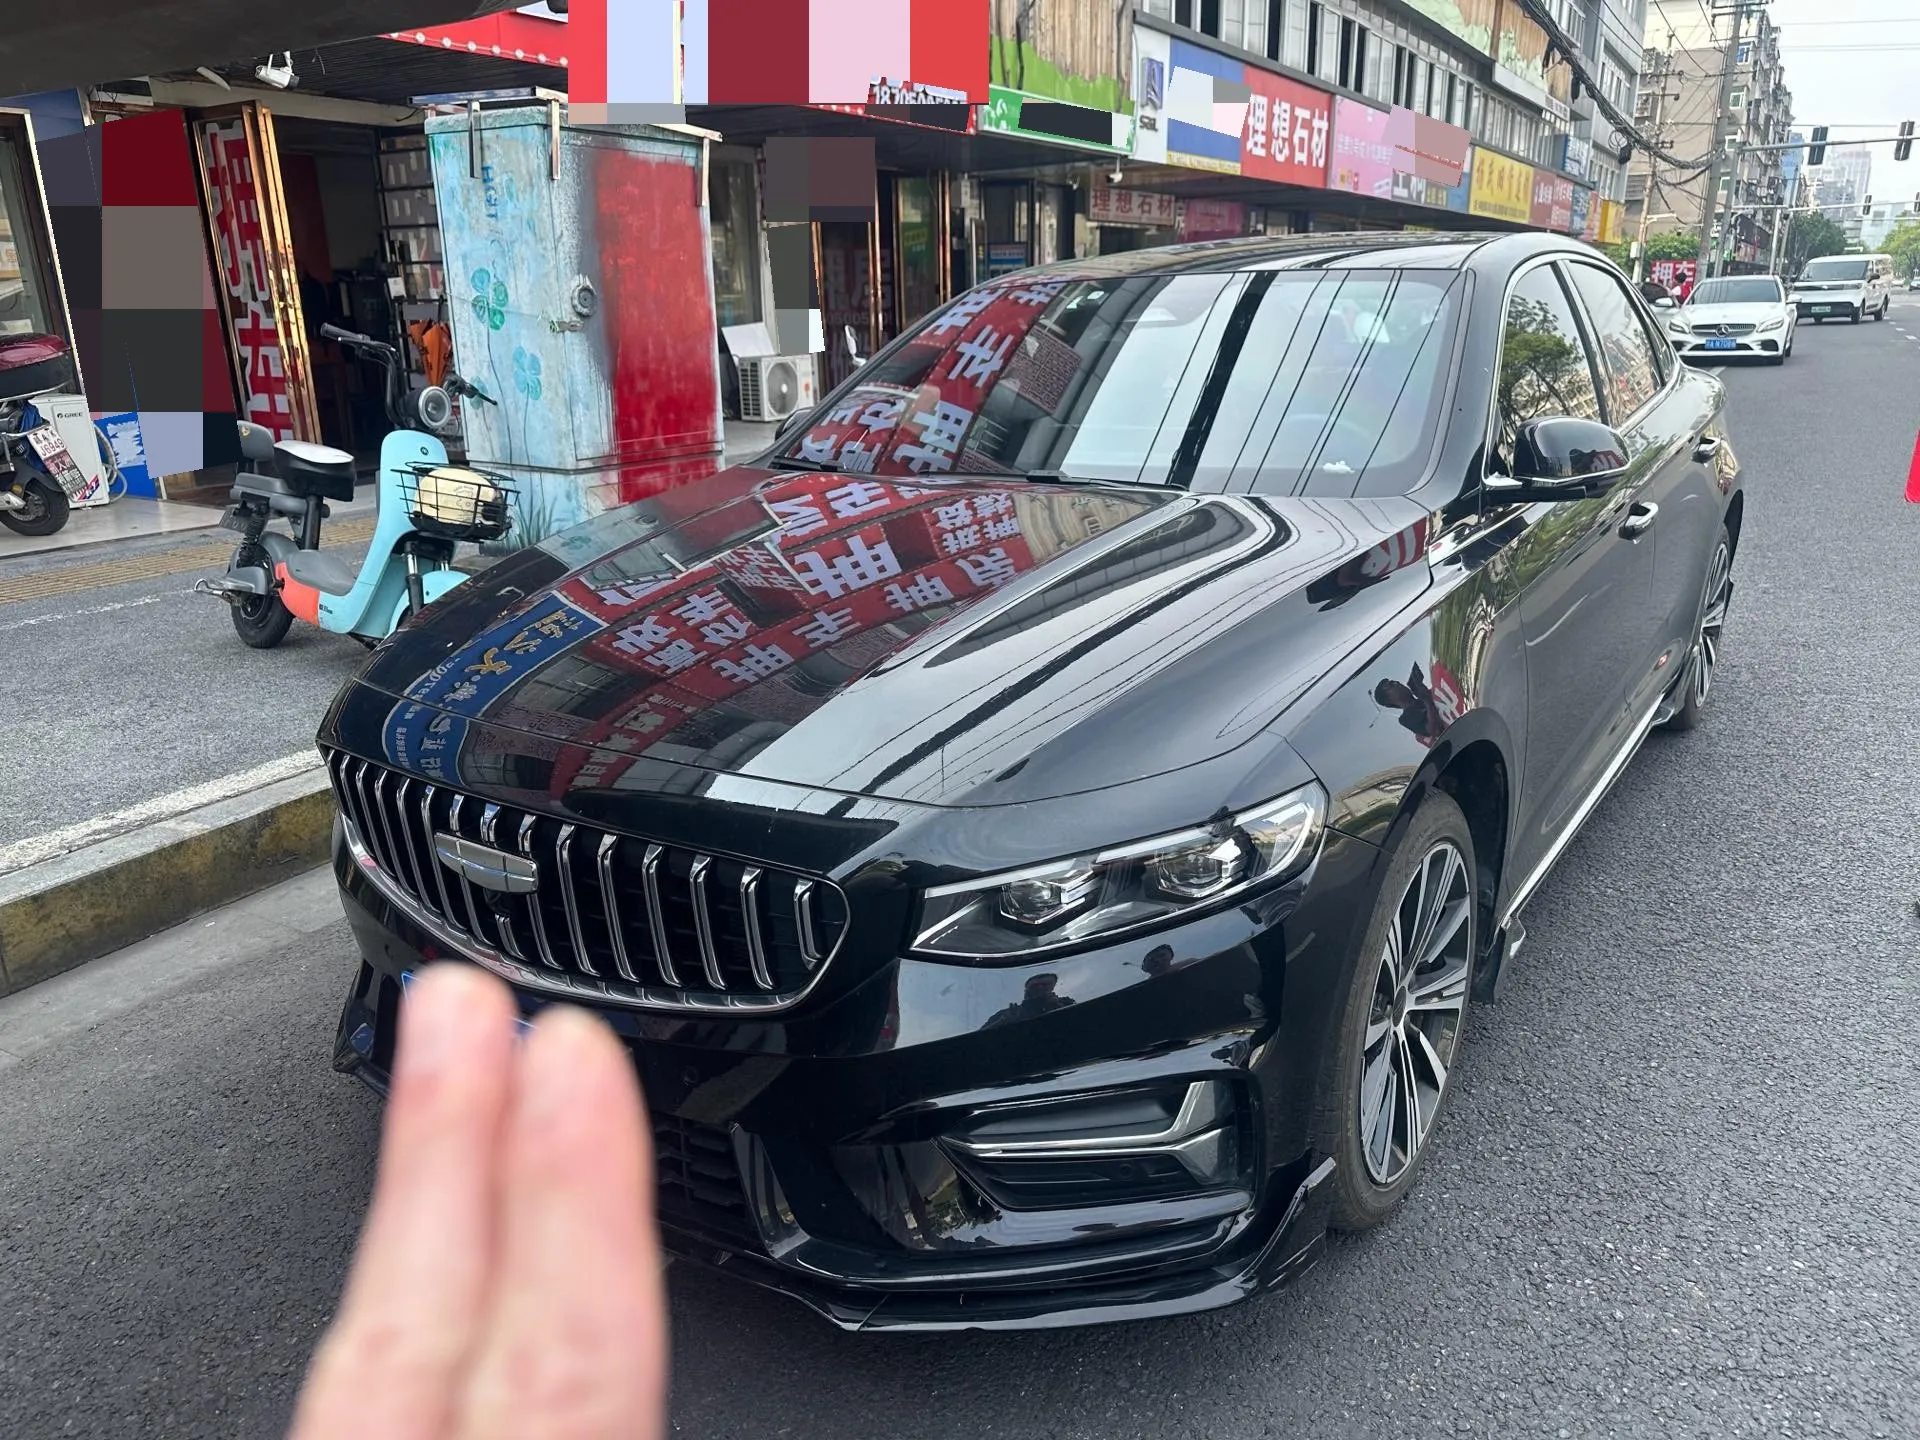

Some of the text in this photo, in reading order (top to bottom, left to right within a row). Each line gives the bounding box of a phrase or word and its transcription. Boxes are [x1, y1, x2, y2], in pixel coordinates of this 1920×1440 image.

[1247, 93, 1330, 169] 理想石材
[1091, 188, 1173, 218] 理想石材
[41, 438, 65, 457] J6949
